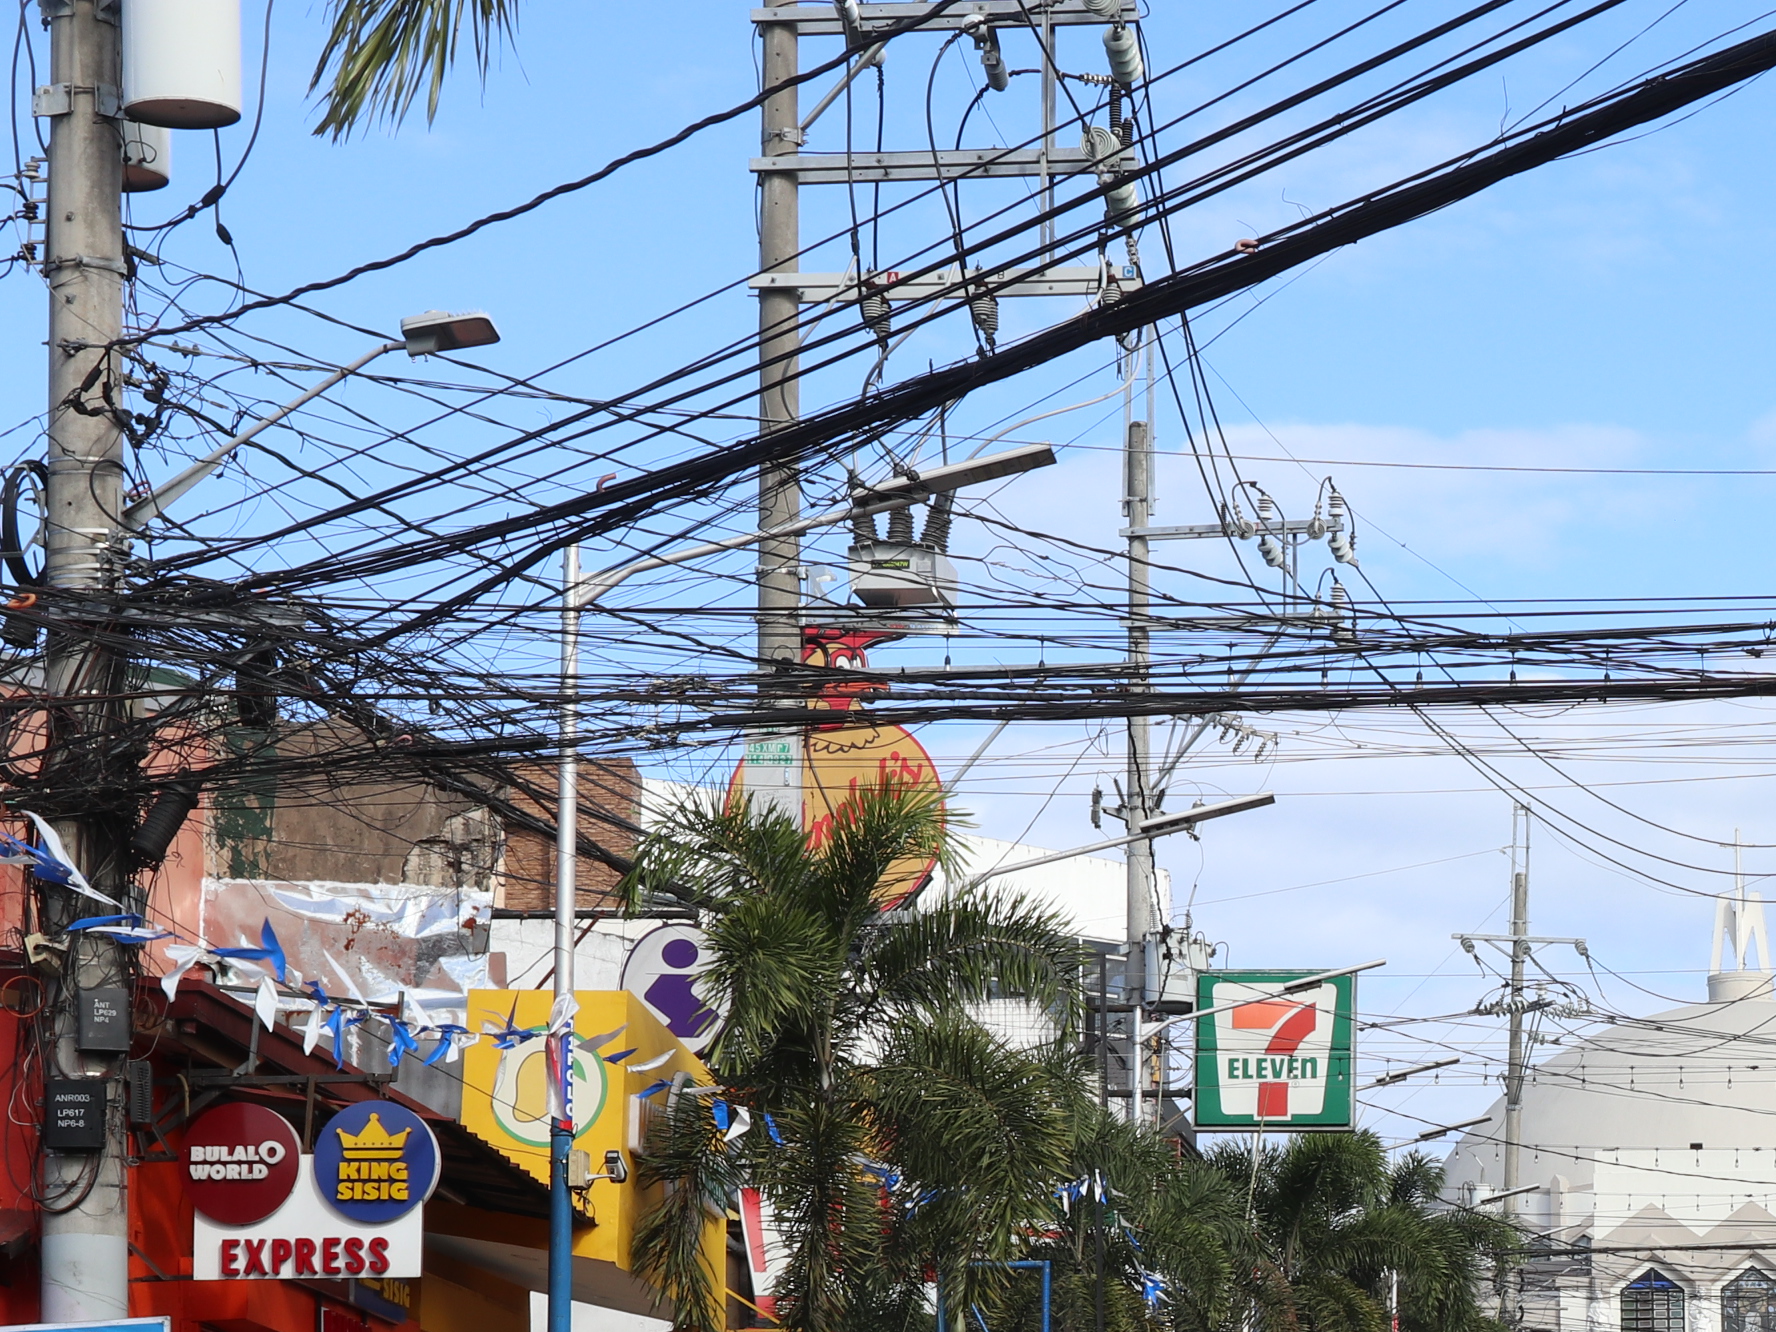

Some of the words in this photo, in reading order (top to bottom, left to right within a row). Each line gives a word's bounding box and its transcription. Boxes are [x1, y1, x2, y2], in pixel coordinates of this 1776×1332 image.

[1232, 1000, 1316, 1116] 7
[58, 1109, 85, 1117] LP617
[58, 1120, 85, 1128] NP6-8
[190, 1140, 286, 1165] BULALO
[189, 1163, 269, 1180] WORLD
[338, 1162, 409, 1180] KING
[336, 1182, 409, 1200] SISIG
[221, 1237, 390, 1275] EXPRESS
